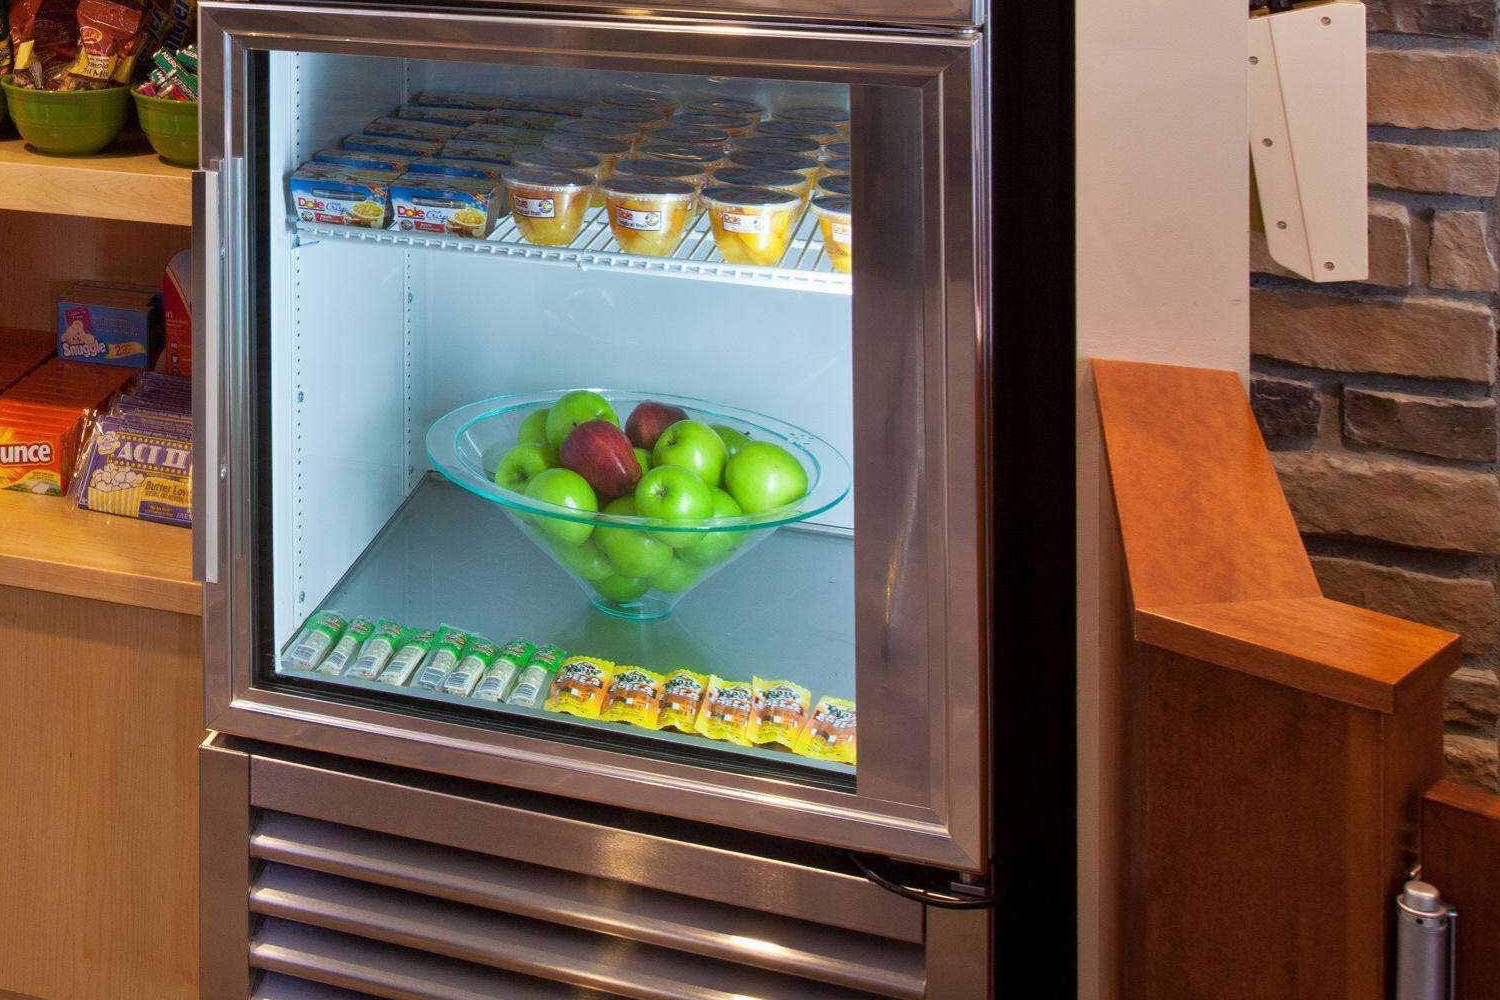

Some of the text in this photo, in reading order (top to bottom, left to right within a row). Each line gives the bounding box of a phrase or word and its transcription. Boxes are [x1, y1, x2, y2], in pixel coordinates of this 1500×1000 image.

[297, 197, 325, 210] Dole
[397, 205, 426, 219] Dole
[62, 342, 107, 358] Snuggle
[115, 441, 191, 469] ACT II
[145, 480, 172, 495] Butter
